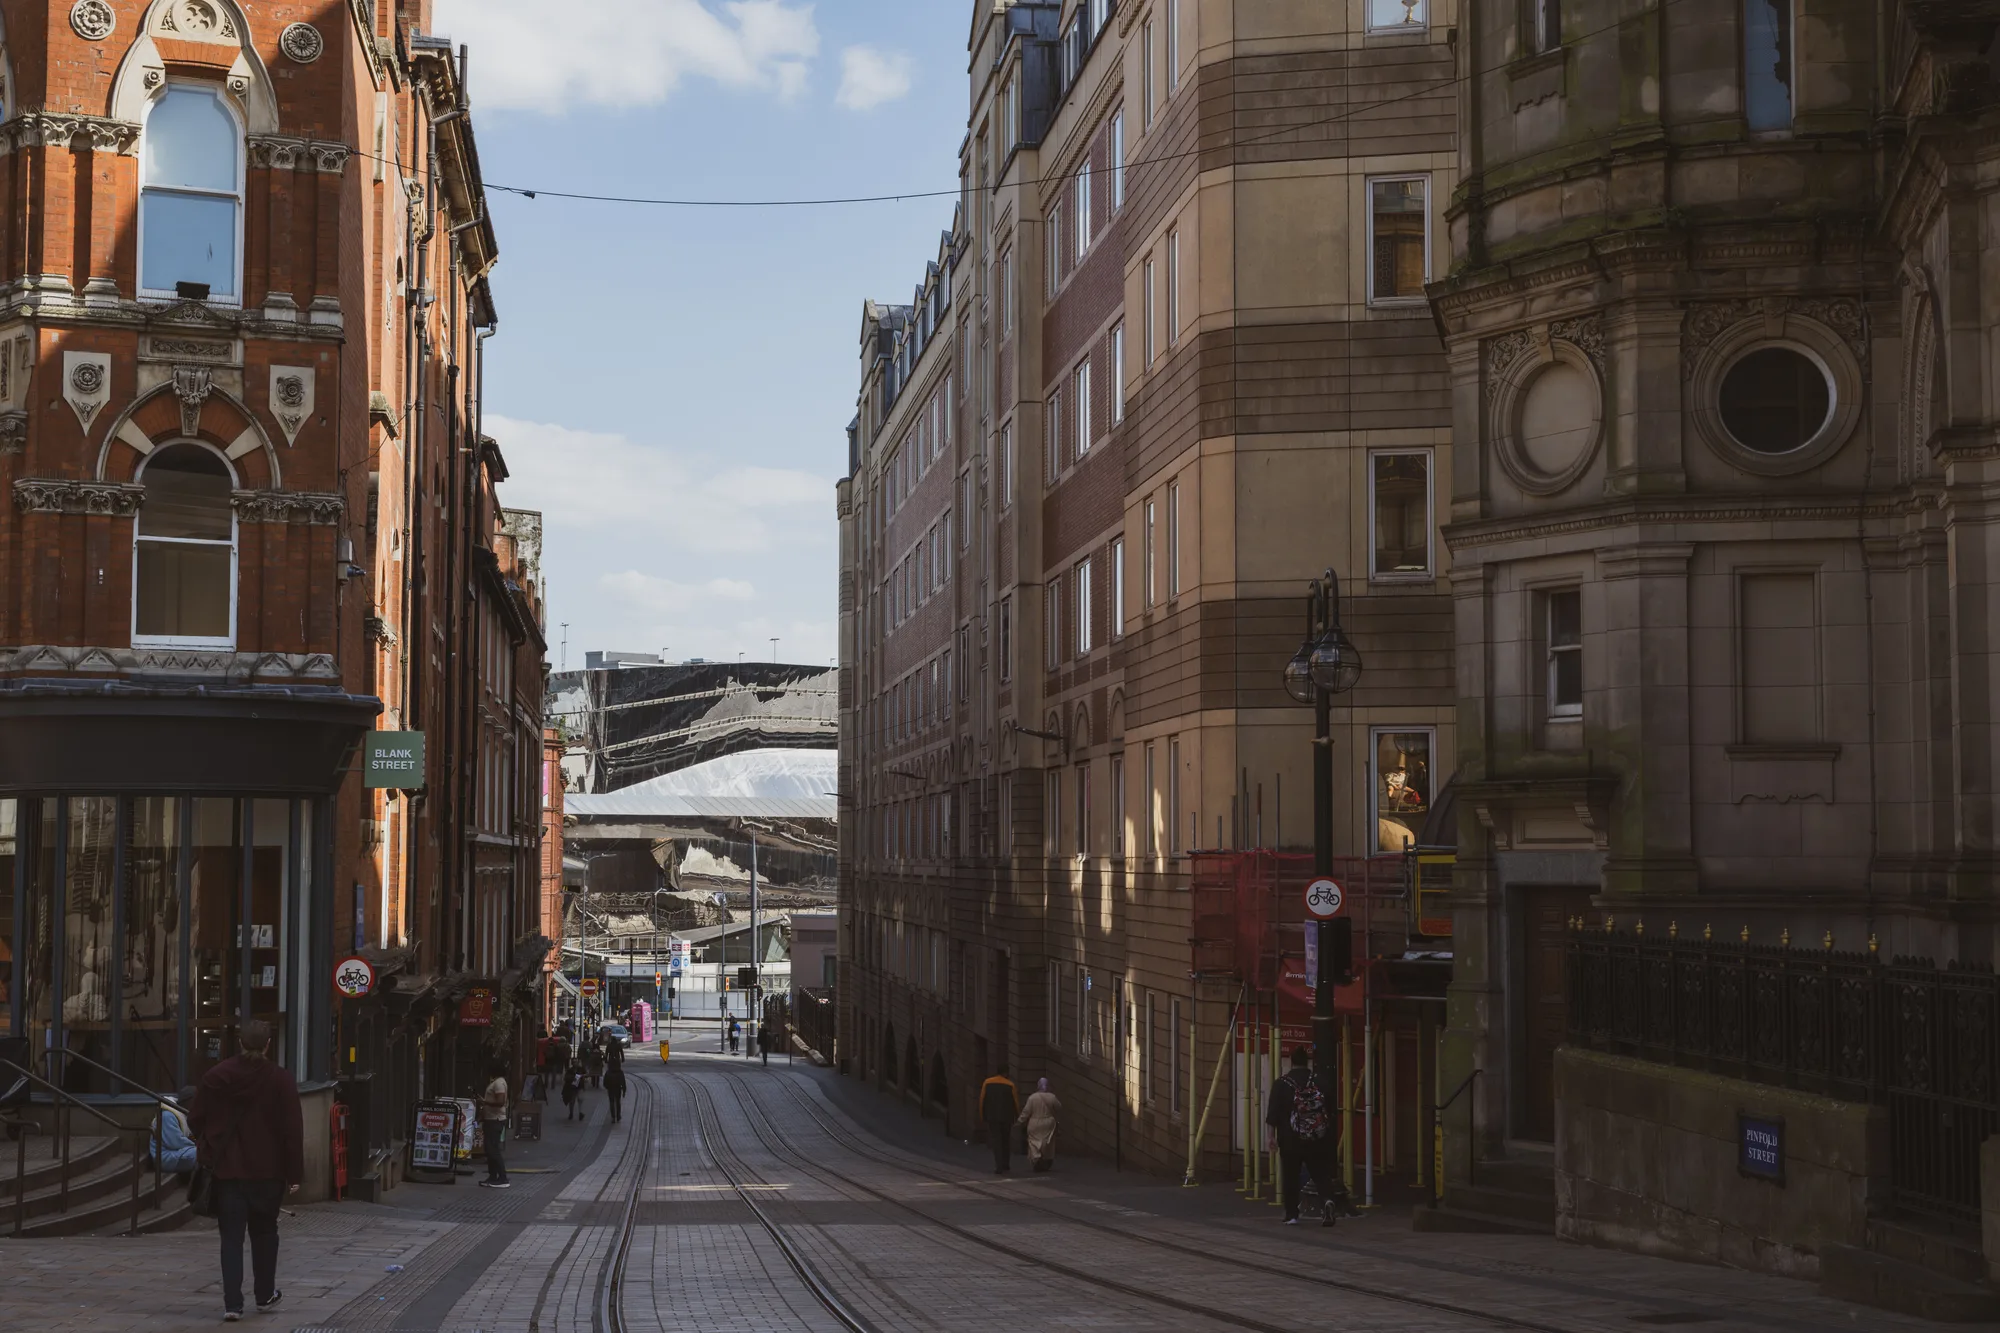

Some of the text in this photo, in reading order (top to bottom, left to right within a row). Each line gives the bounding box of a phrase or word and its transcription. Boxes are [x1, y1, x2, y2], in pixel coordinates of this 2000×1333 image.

[375, 749, 412, 758] BLANK
[372, 760, 415, 770] STREET
[1285, 971, 1306, 979] Birmin
[1294, 1029, 1306, 1038] box
[1746, 1129, 1777, 1147] PINFOLD
[1748, 1147, 1776, 1164] STREET
